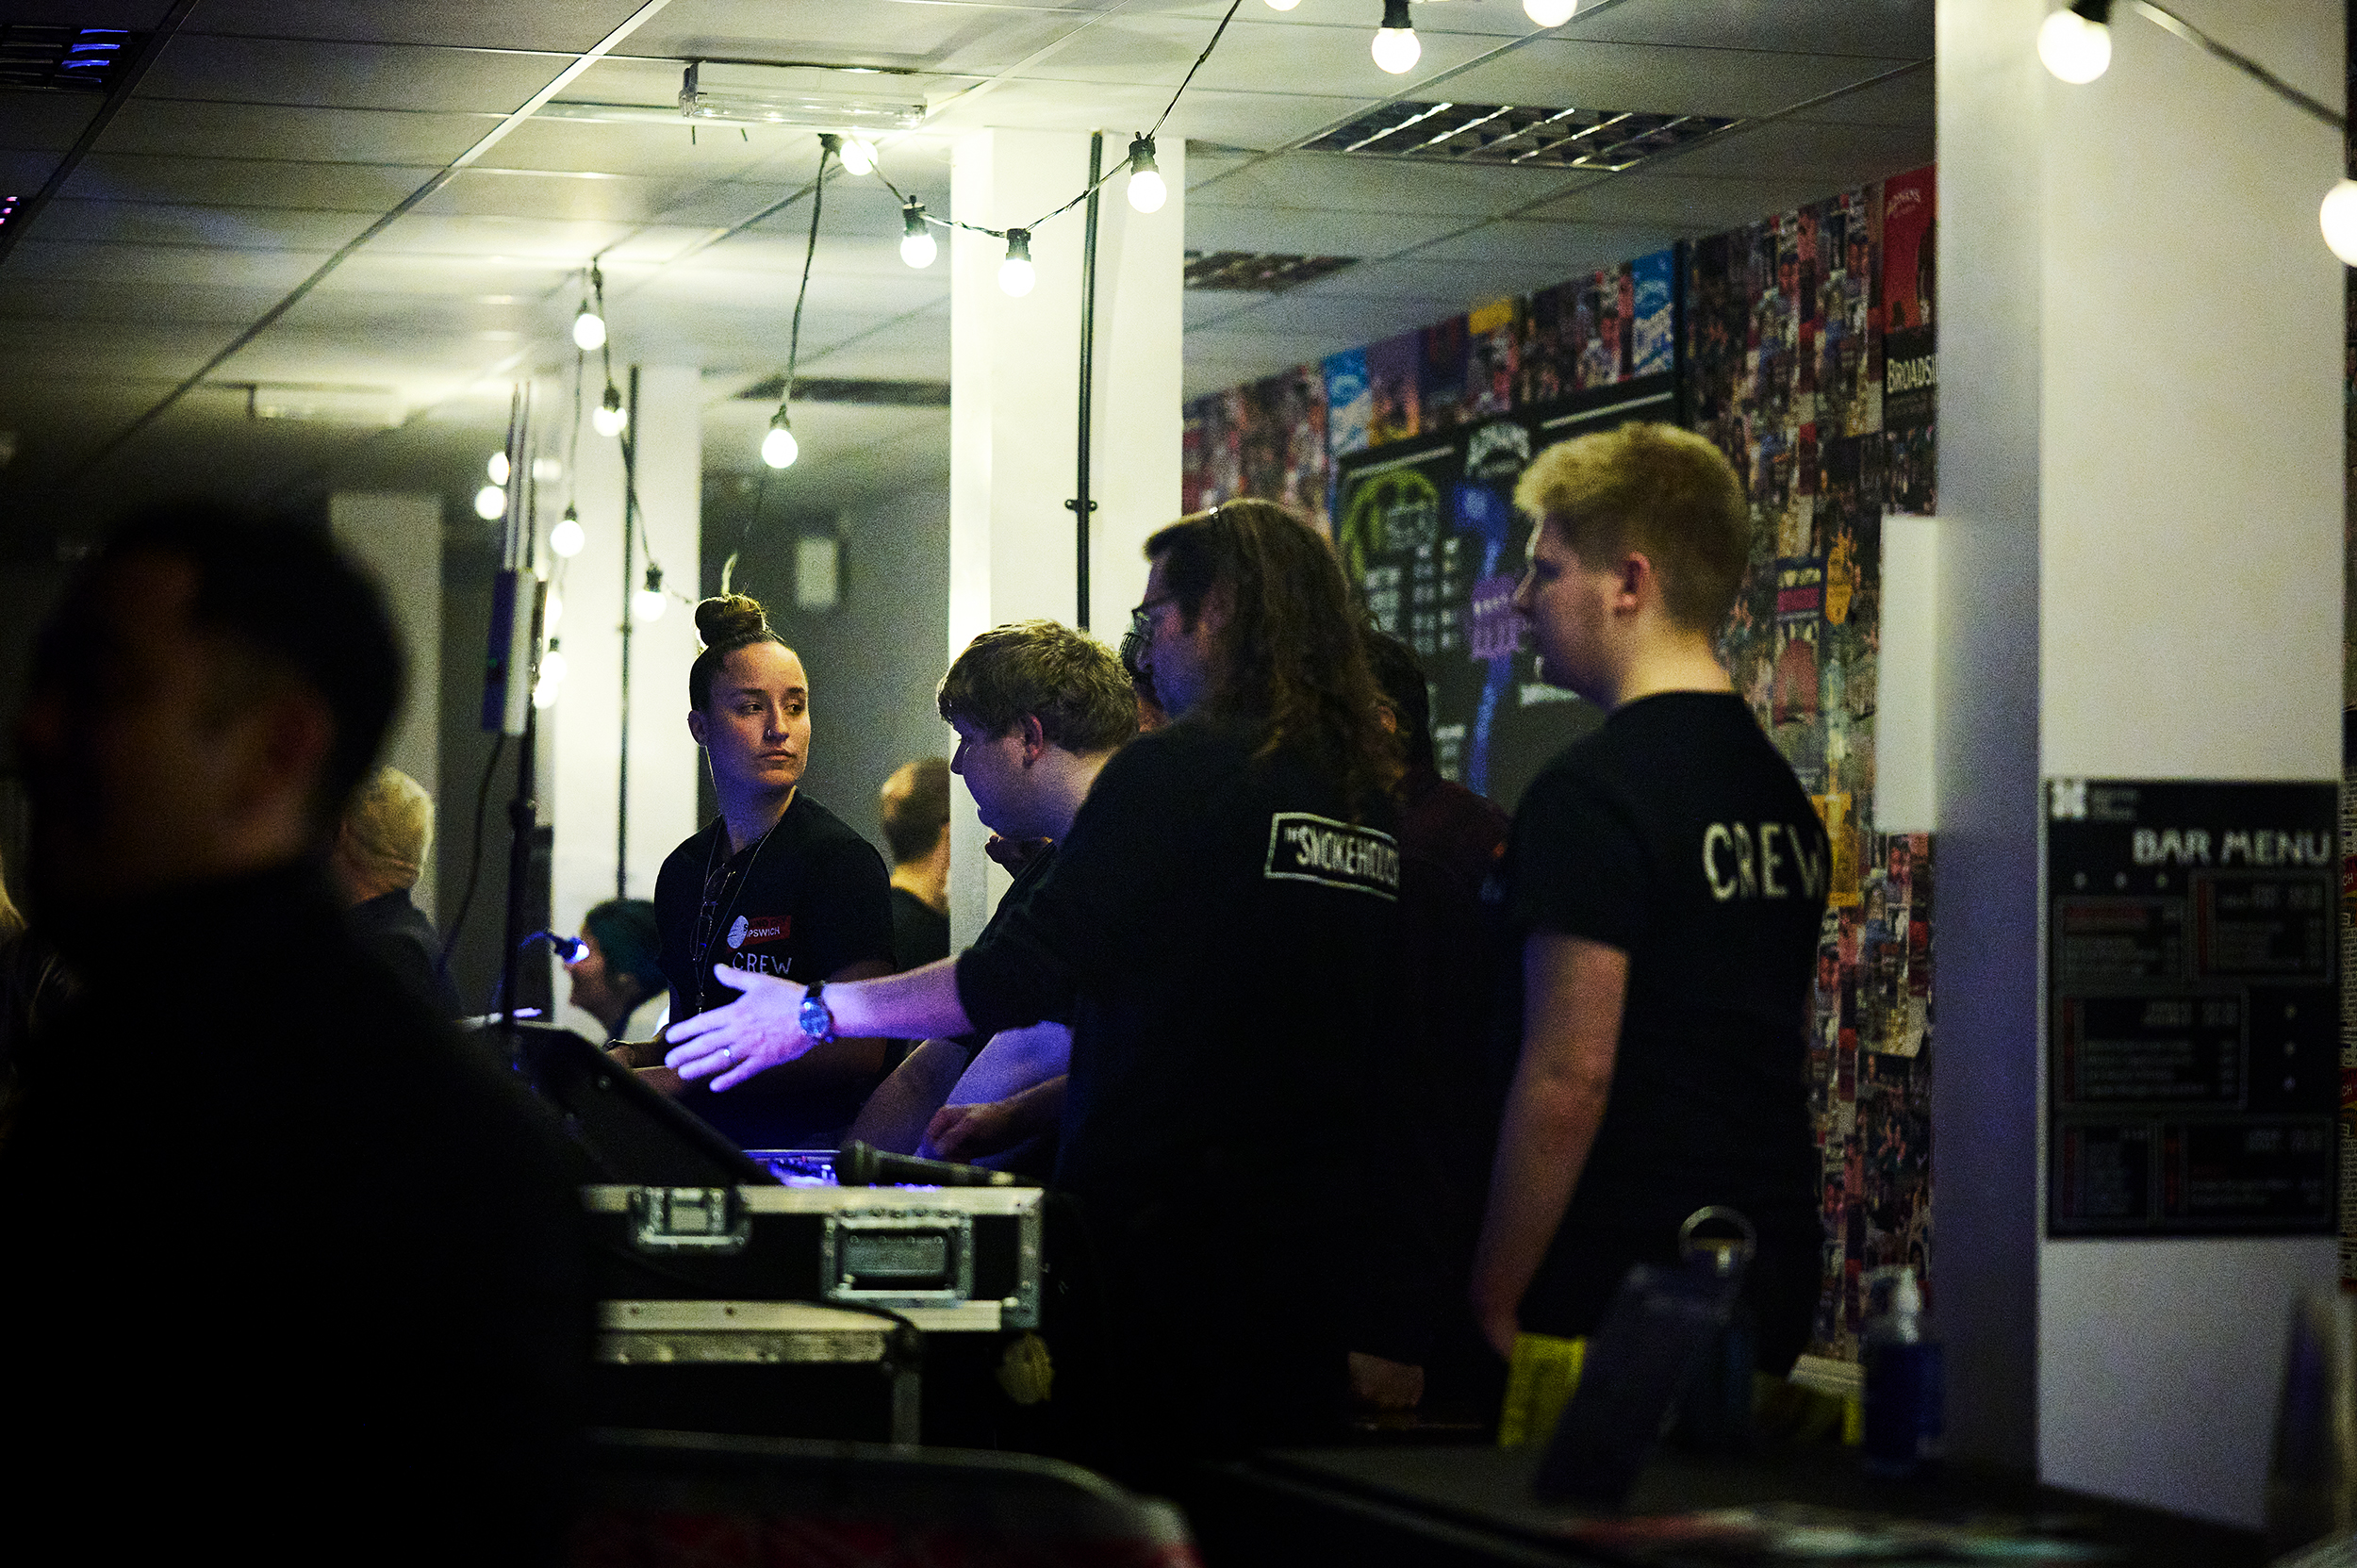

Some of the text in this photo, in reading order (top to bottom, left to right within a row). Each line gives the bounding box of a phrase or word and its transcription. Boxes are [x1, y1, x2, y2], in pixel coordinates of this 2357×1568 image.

[1702, 820, 1827, 902] CREW
[2133, 828, 2332, 866] BAR MENU
[732, 951, 792, 975] CREW
